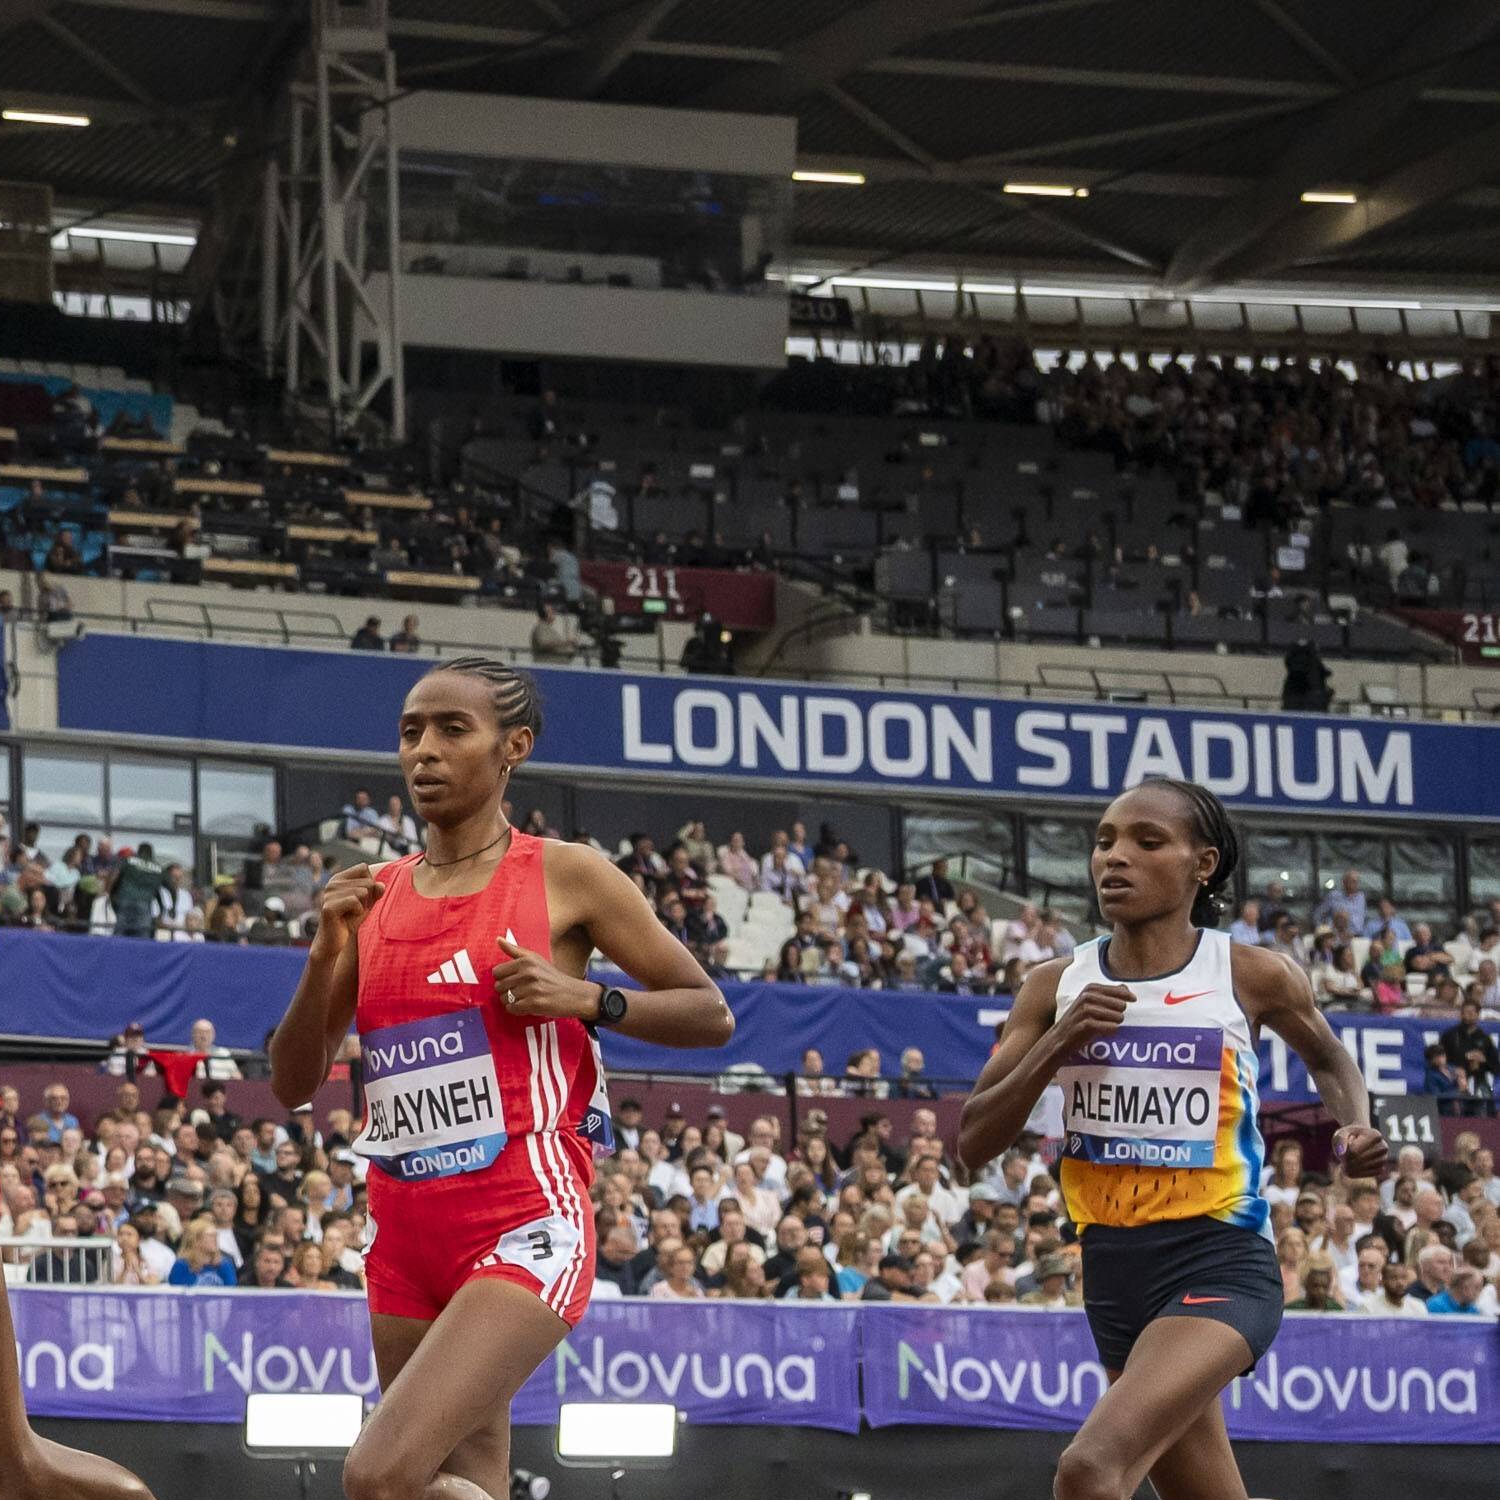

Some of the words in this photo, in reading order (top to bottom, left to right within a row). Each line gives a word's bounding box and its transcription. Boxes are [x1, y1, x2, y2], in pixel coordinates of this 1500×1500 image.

[625, 566, 681, 599] 211
[1463, 613, 1500, 643] 21
[622, 684, 994, 784] LONDON
[1014, 709, 1413, 806] STADIUM
[1260, 1024, 1407, 1096] TE
[366, 1075, 494, 1143] BELAYNEH
[1071, 1080, 1211, 1127] ALEMAYO
[1385, 1114, 1435, 1143] 111
[400, 1144, 485, 1177] LONDON
[1103, 1139, 1192, 1162] LONDON
[527, 1230, 554, 1261] 3
[555, 1336, 817, 1402] Novuna
[899, 1341, 1106, 1406] Novun
